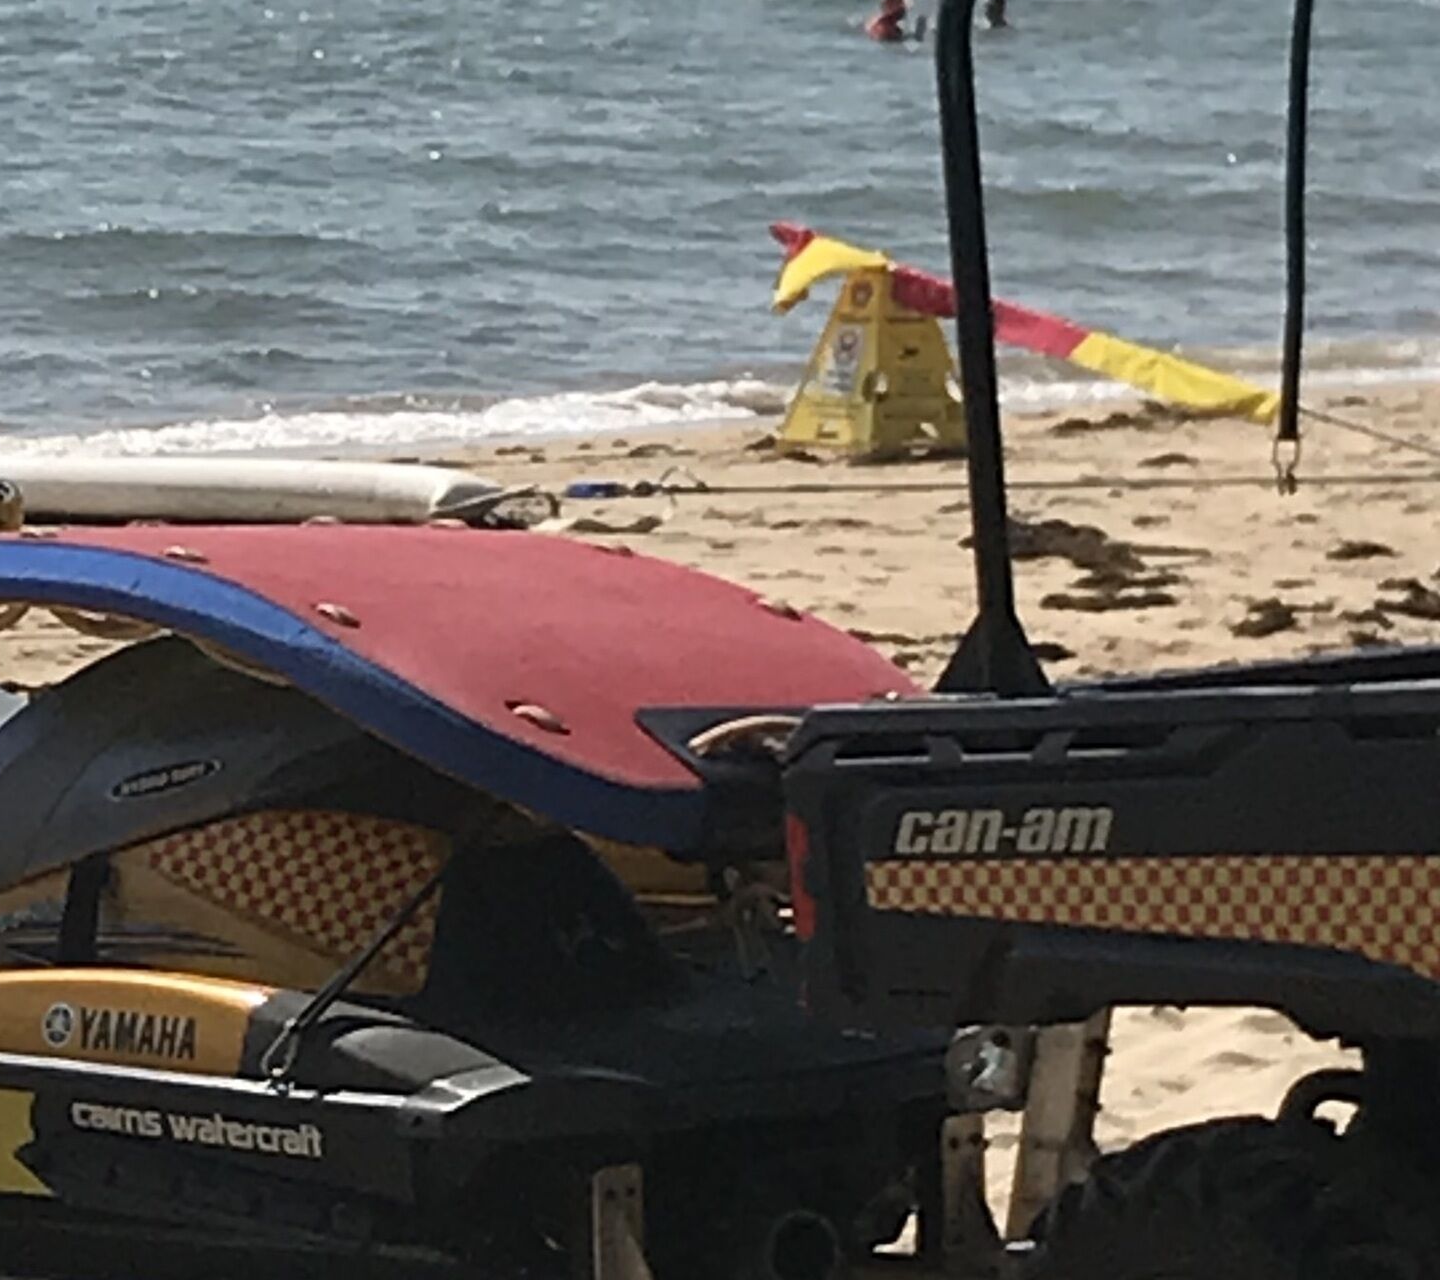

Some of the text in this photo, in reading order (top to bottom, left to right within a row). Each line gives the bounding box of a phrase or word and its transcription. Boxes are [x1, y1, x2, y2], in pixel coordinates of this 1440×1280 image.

[895, 806, 1113, 853] can-am
[80, 1007, 196, 1060] YAMAHA
[71, 1102, 322, 1157] cairns watercraft
